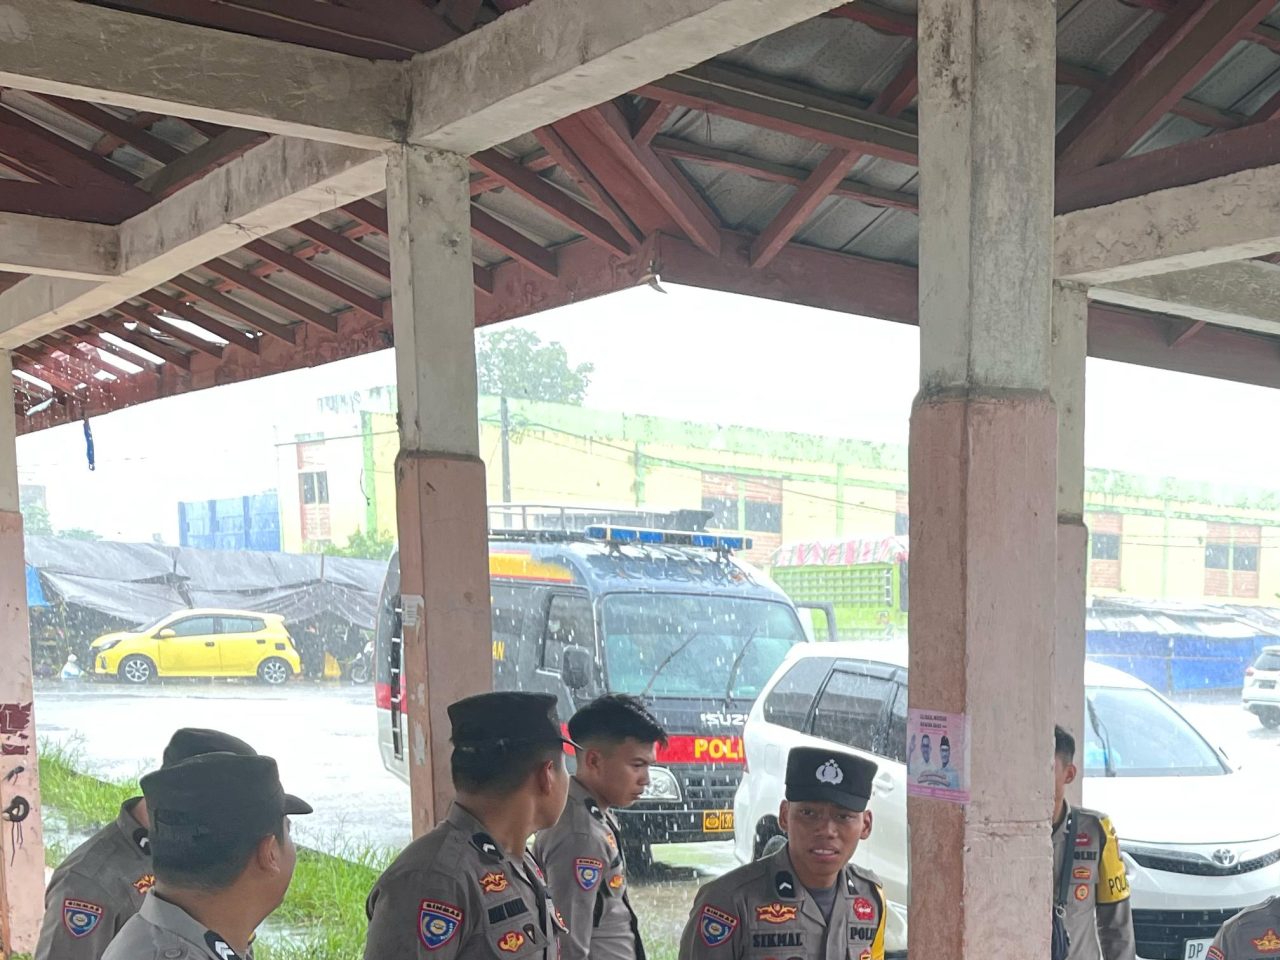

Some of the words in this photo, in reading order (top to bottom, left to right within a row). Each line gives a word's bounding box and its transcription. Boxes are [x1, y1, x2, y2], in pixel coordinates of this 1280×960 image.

[700, 713, 749, 725] ISUZ
[426, 903, 460, 917] BINMAS
[1188, 943, 1204, 958] DP
